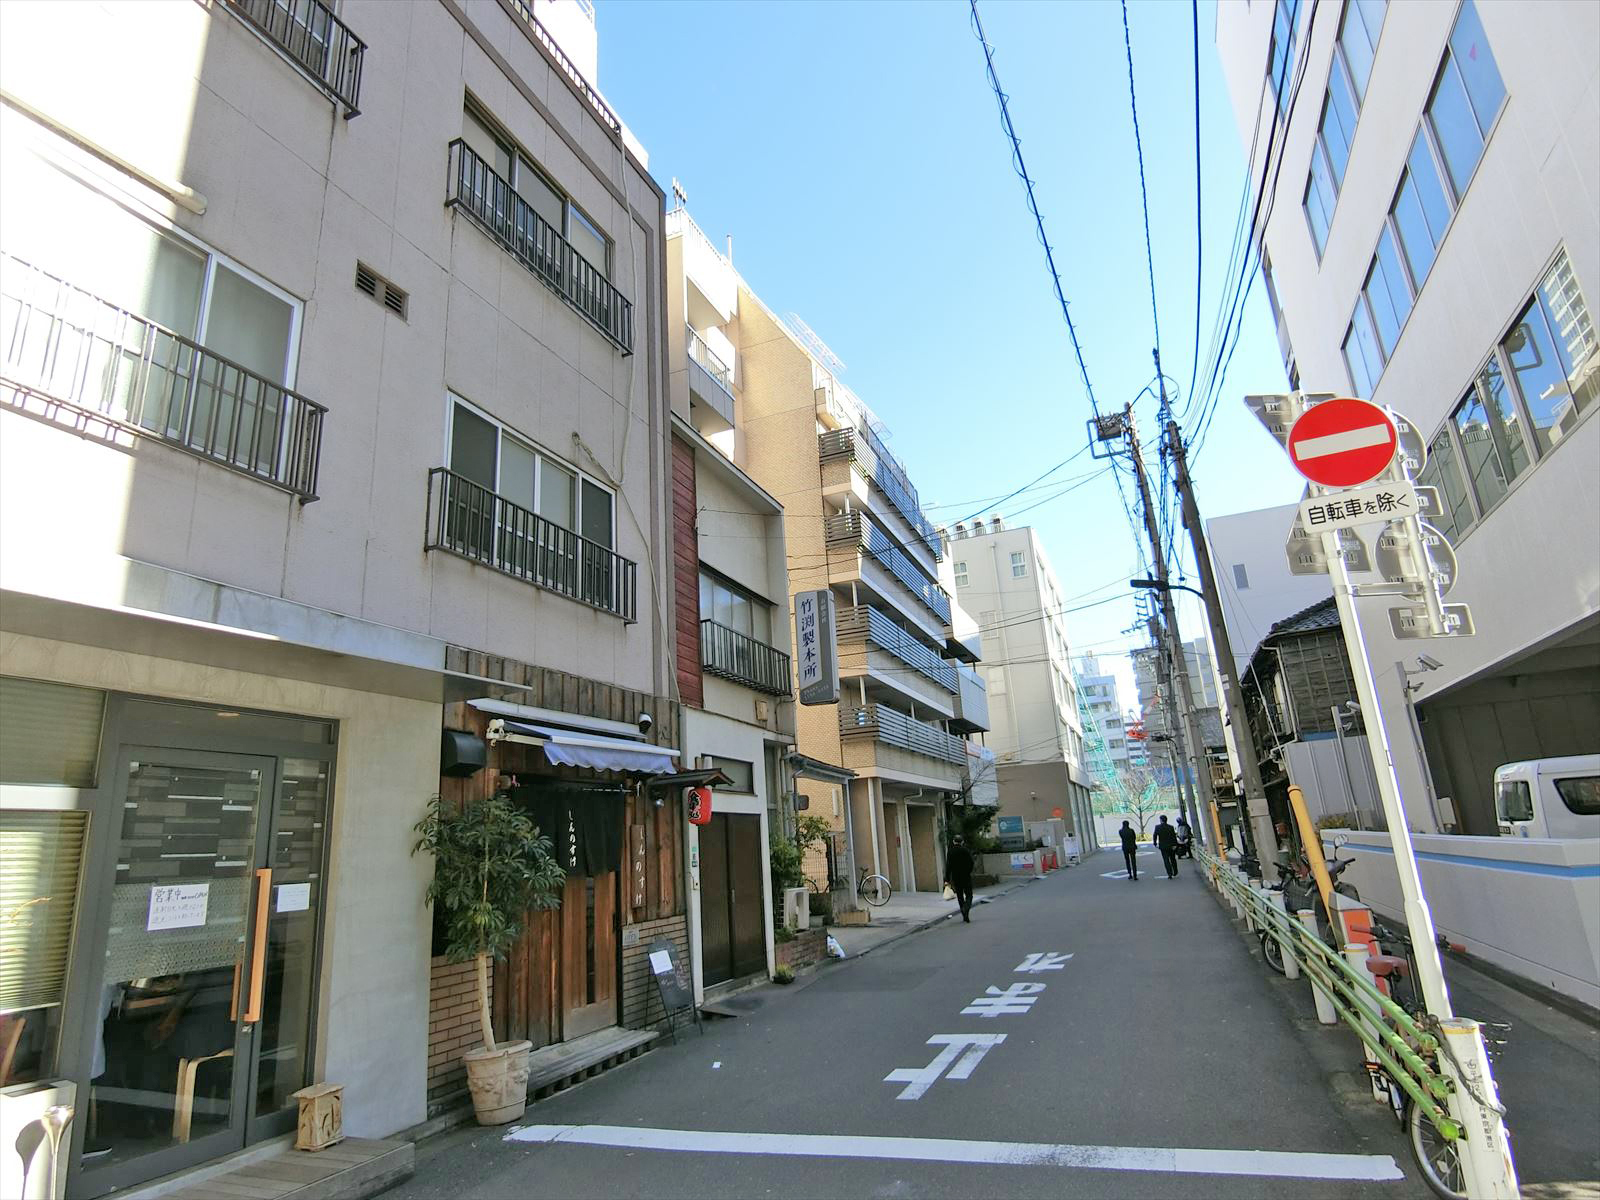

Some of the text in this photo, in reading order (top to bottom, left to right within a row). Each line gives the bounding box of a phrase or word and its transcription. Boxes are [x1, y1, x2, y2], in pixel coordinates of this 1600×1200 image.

[1308, 492, 1410, 525] 自転車を除く
[568, 808, 577, 867] しんのすけ
[635, 826, 645, 905] しんのすけ
[882, 951, 1075, 1100] 止まれ
